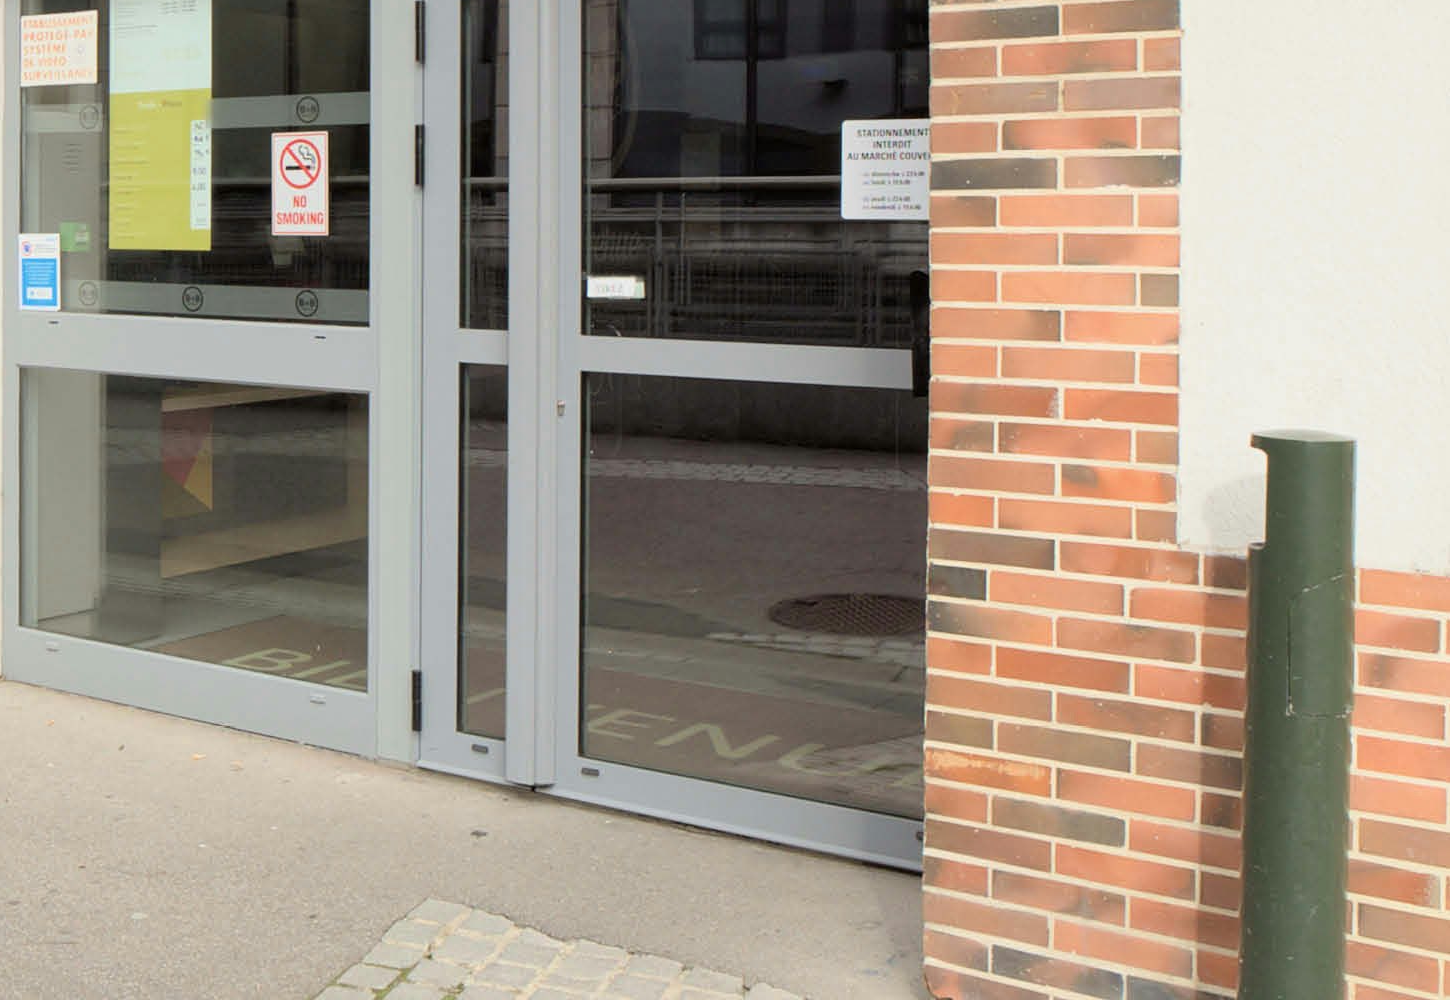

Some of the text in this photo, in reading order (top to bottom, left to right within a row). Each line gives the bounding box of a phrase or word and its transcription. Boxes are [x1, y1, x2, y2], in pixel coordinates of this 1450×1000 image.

[873, 140, 912, 149] INTERDIT
[847, 152, 860, 161] AU
[293, 195, 307, 209] NO
[276, 212, 324, 225] SMOKING
